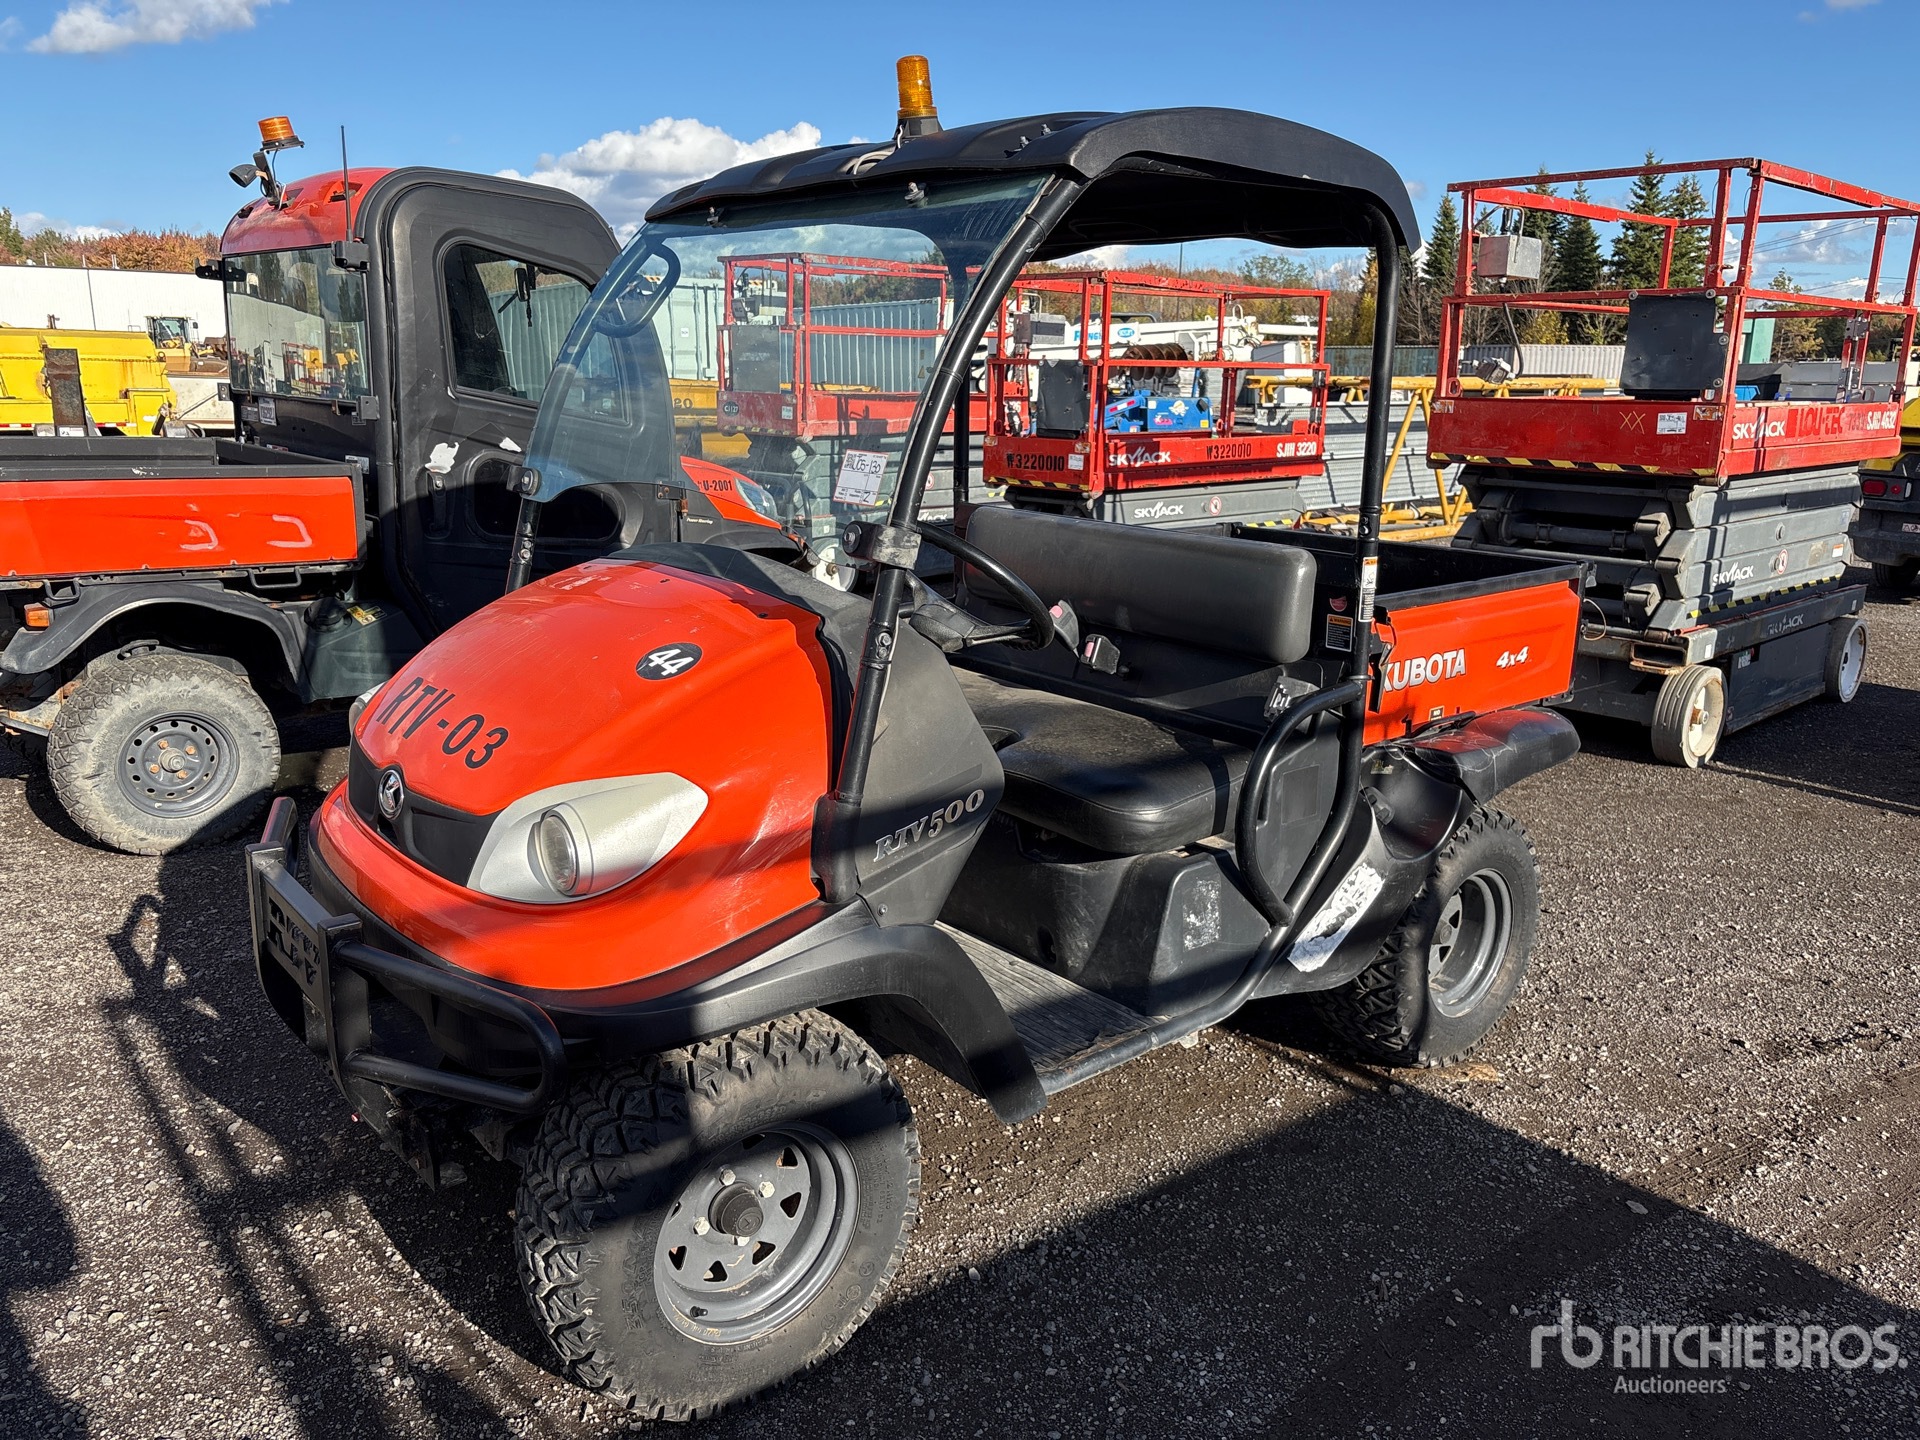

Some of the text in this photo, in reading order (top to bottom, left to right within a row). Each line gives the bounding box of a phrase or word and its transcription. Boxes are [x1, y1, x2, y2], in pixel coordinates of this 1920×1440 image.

[1732, 413, 1785, 440] SKYJACK
[1109, 446, 1171, 467] SKYJACK
[1296, 442, 1317, 456] 3220
[697, 480, 733, 491] U-2001
[1134, 501, 1184, 518] SKYJACK
[1712, 561, 1754, 587] SKYJACK
[648, 648, 694, 676] 44
[376, 677, 509, 769] RTV-03
[873, 789, 985, 863] RTV500
